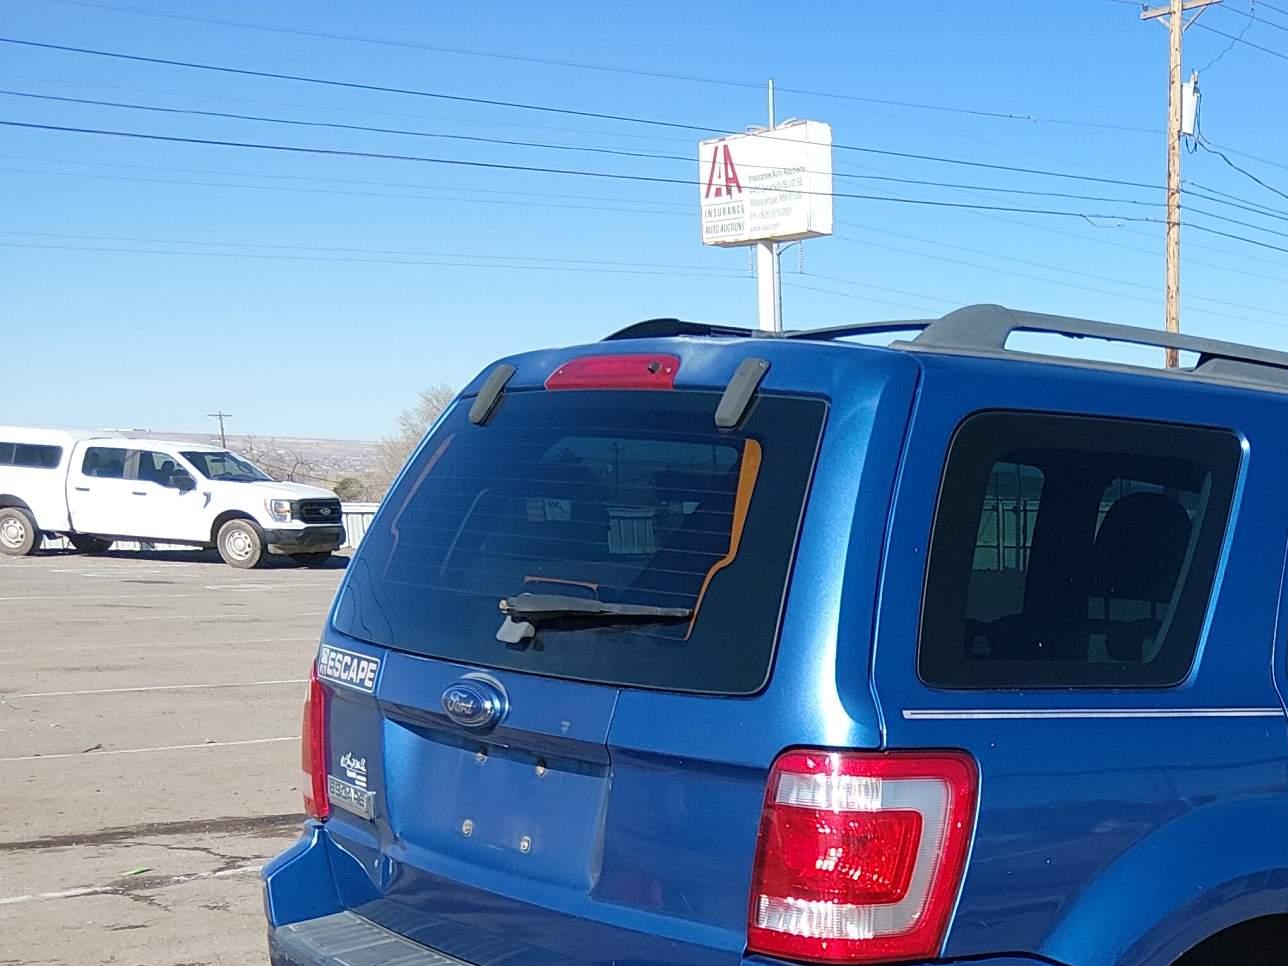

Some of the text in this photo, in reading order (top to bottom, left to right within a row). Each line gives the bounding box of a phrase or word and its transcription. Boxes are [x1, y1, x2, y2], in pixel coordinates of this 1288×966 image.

[704, 203, 745, 219] INSURANCE
[705, 223, 720, 235] AUTO
[720, 221, 745, 233] AUCTIONS
[327, 651, 378, 688] ESCAPE
[447, 690, 475, 715] Ford
[329, 780, 367, 810] ESCAPE
